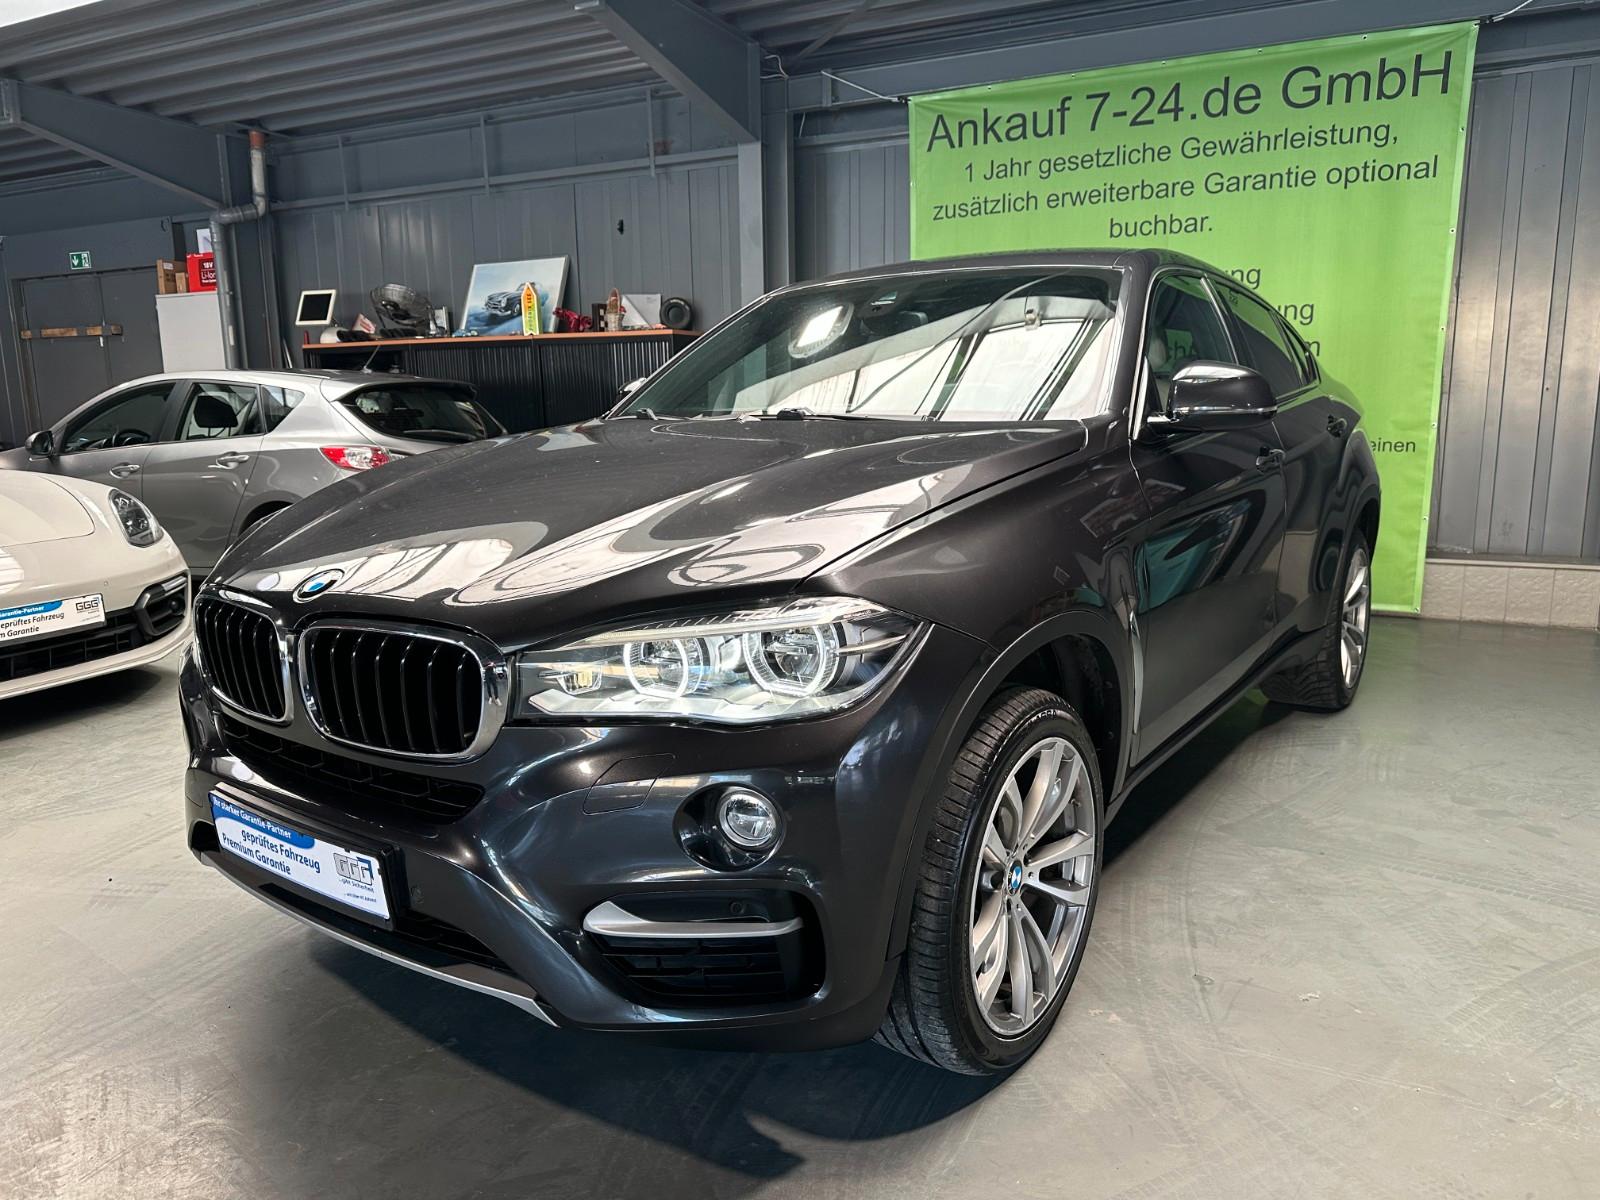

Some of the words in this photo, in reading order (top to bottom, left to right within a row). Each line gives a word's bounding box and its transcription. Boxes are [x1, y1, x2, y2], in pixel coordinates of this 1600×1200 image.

[926, 96, 1072, 152] Ankauf
[1086, 76, 1262, 131] 7-24.de
[1282, 50, 1453, 109] GmbH
[964, 162, 973, 182] 1
[983, 157, 1031, 181] Jahr
[1038, 142, 1171, 179] gesetzliche
[1181, 122, 1398, 159] Gewährleistung,
[932, 190, 1038, 221] zusätzlich
[1046, 179, 1194, 208] erweiterbare
[1204, 165, 1316, 194] Garantie
[1326, 154, 1438, 189] optional
[1109, 213, 1213, 239] buchbar.
[0, 618, 31, 629] eprüftes
[32, 612, 64, 623] Fahrzeug
[7, 626, 39, 637] Garantie
[222, 832, 254, 858] Premium
[255, 849, 291, 875] Garantie
[241, 829, 279, 853] geprüftes
[279, 844, 321, 873] Fahrzeug
